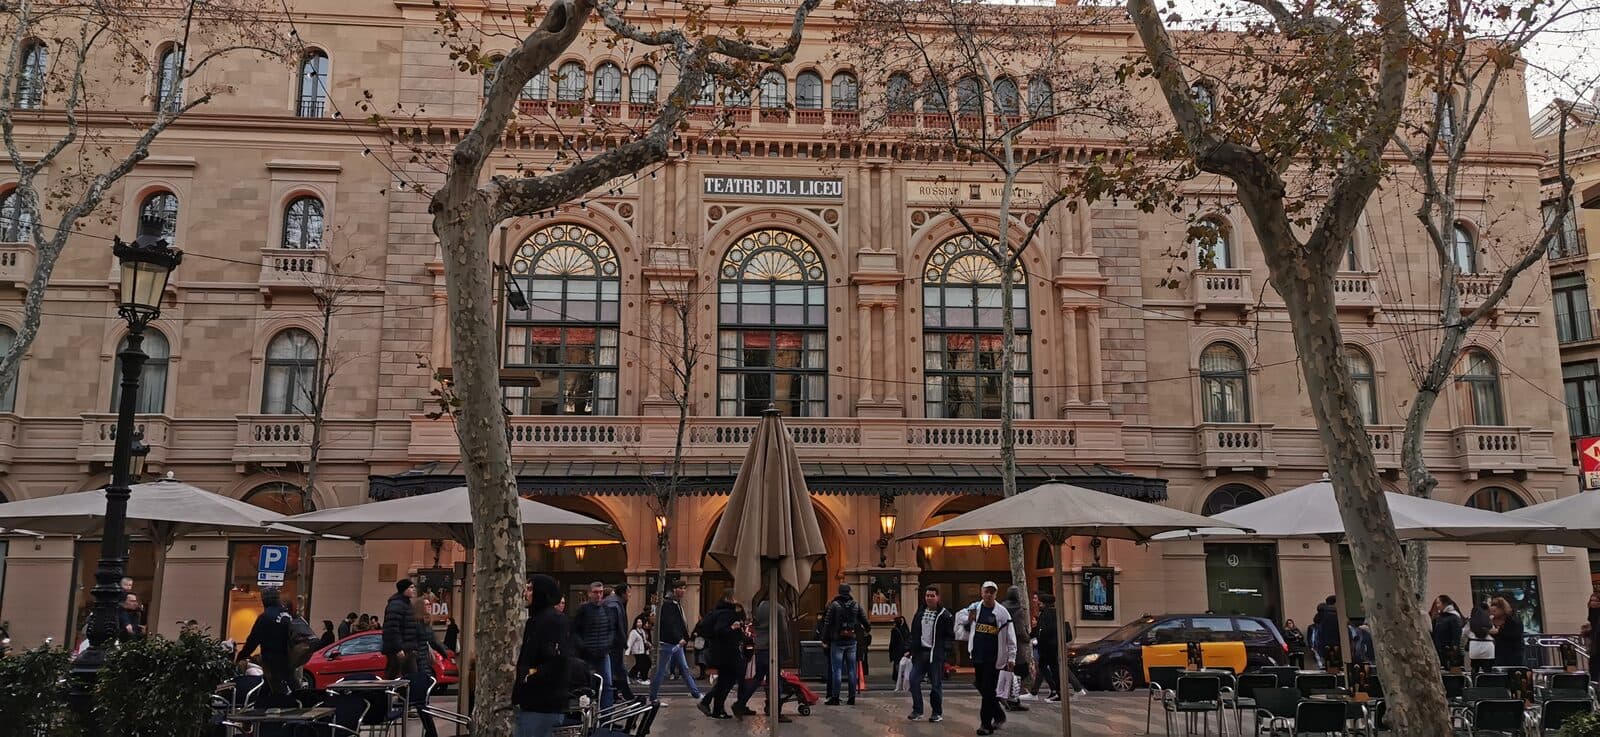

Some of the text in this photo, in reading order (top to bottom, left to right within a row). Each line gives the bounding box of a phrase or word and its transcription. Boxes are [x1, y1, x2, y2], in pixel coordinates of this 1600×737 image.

[705, 177, 842, 196] TEATRE DEL LICEU
[990, 187, 1032, 198] MOATIN
[264, 548, 282, 568] P
[432, 602, 449, 615] DA
[871, 602, 898, 616] AIDA
